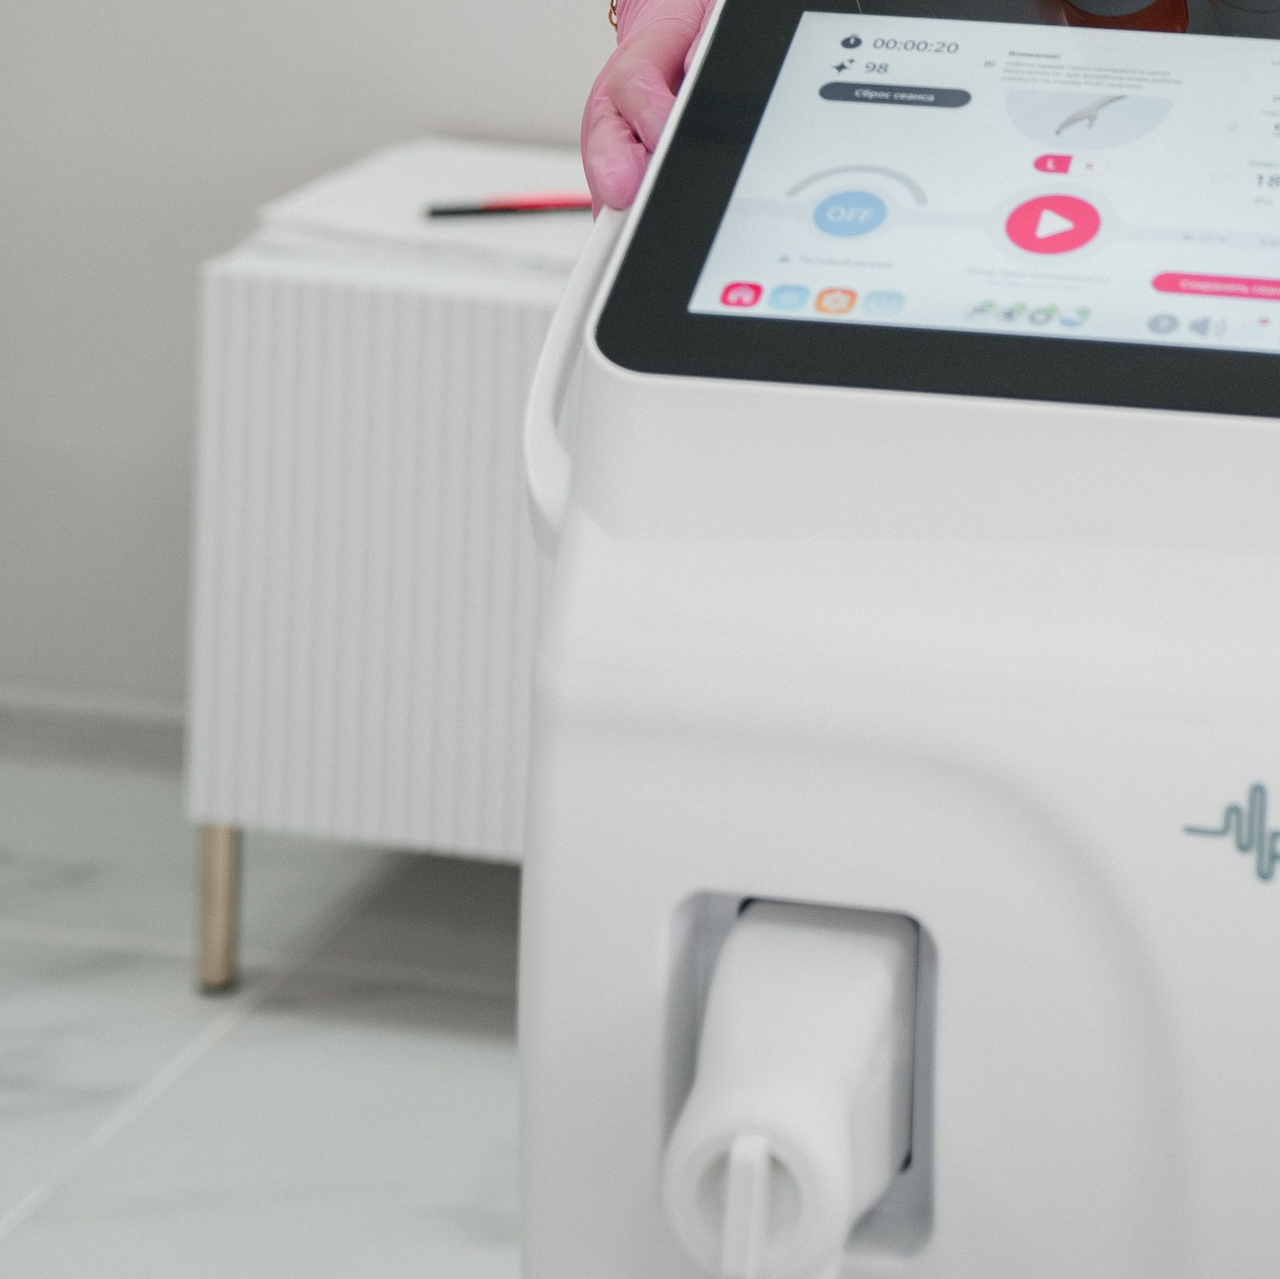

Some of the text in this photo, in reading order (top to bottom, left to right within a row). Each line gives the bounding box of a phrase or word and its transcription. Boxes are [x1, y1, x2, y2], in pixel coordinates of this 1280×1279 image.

[873, 38, 959, 54] 00:00:20
[864, 61, 889, 74] 98
[826, 205, 875, 223] OFF
